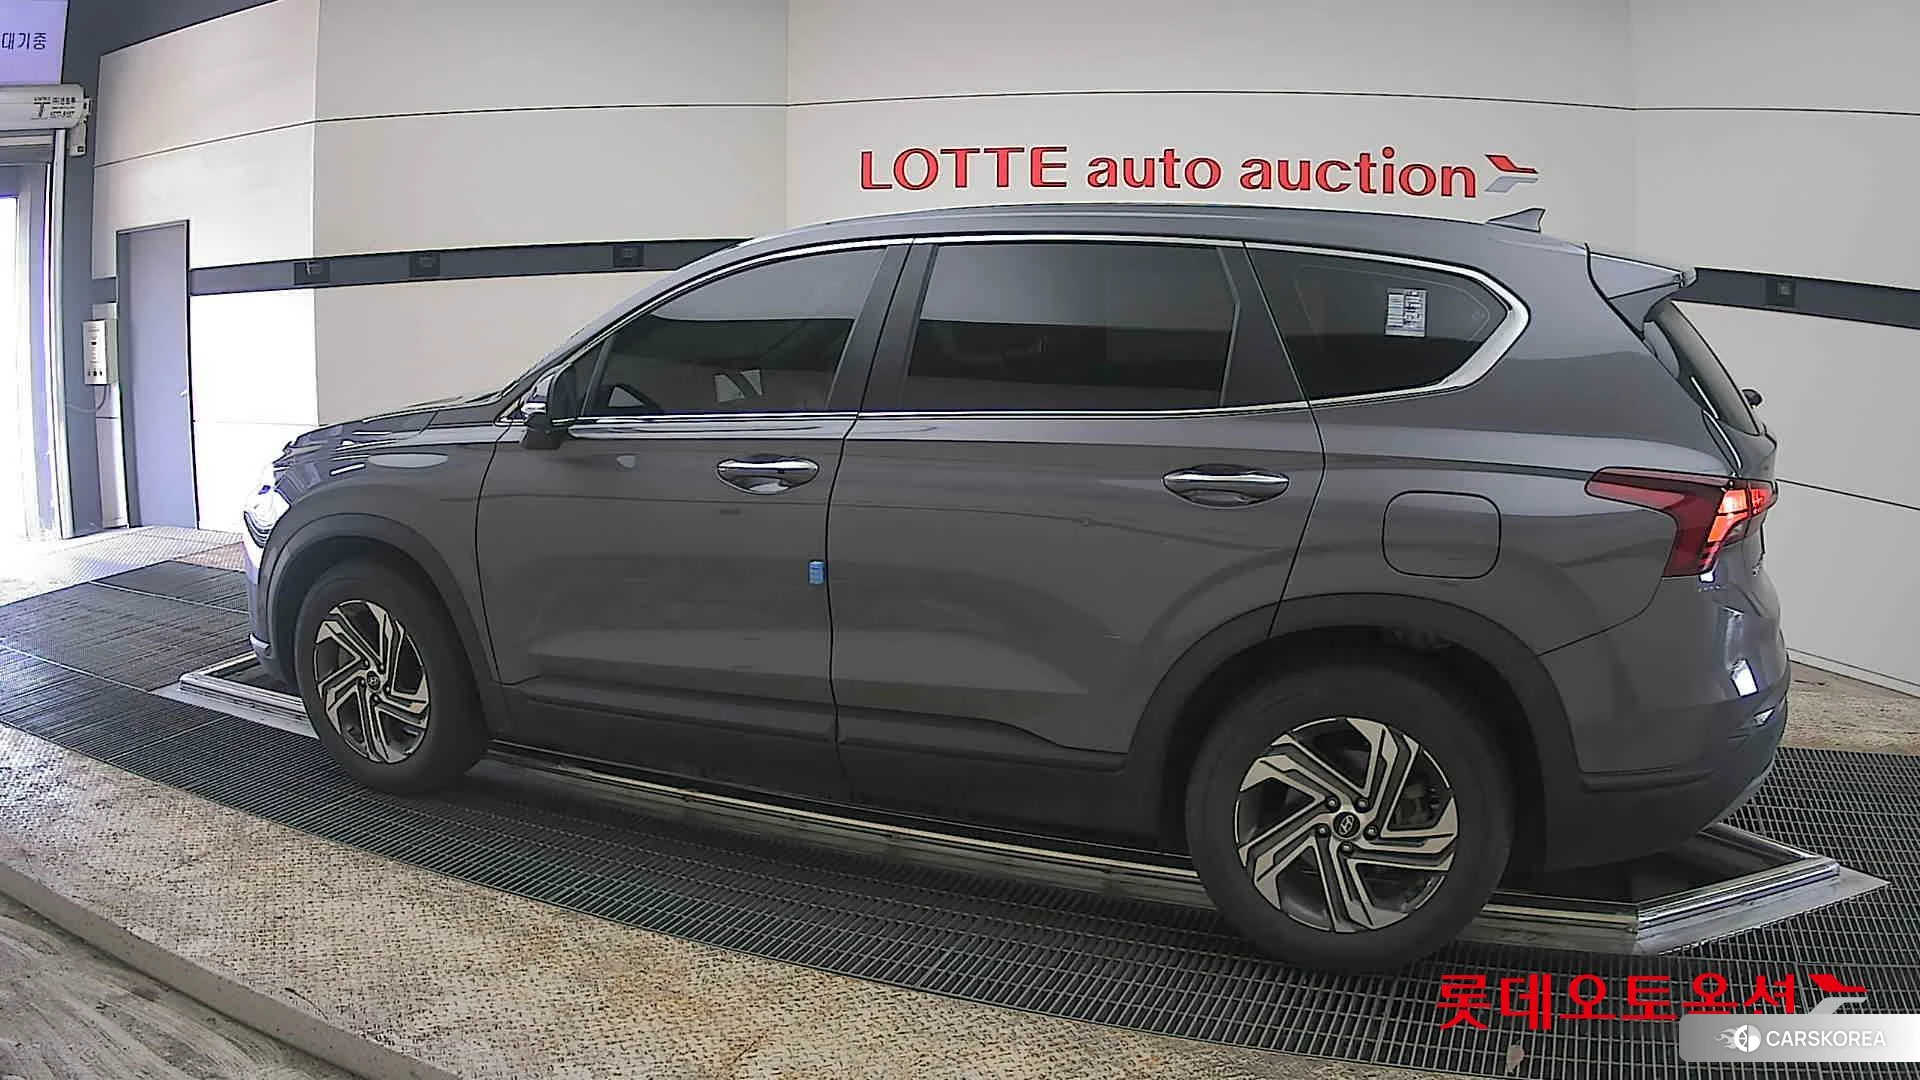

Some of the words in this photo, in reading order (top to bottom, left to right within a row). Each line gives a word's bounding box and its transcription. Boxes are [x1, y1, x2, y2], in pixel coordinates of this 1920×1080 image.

[1, 32, 47, 50] 대기중
[861, 146, 1068, 191] LOTTE
[1087, 149, 1223, 189] auto
[1240, 147, 1477, 198] auction
